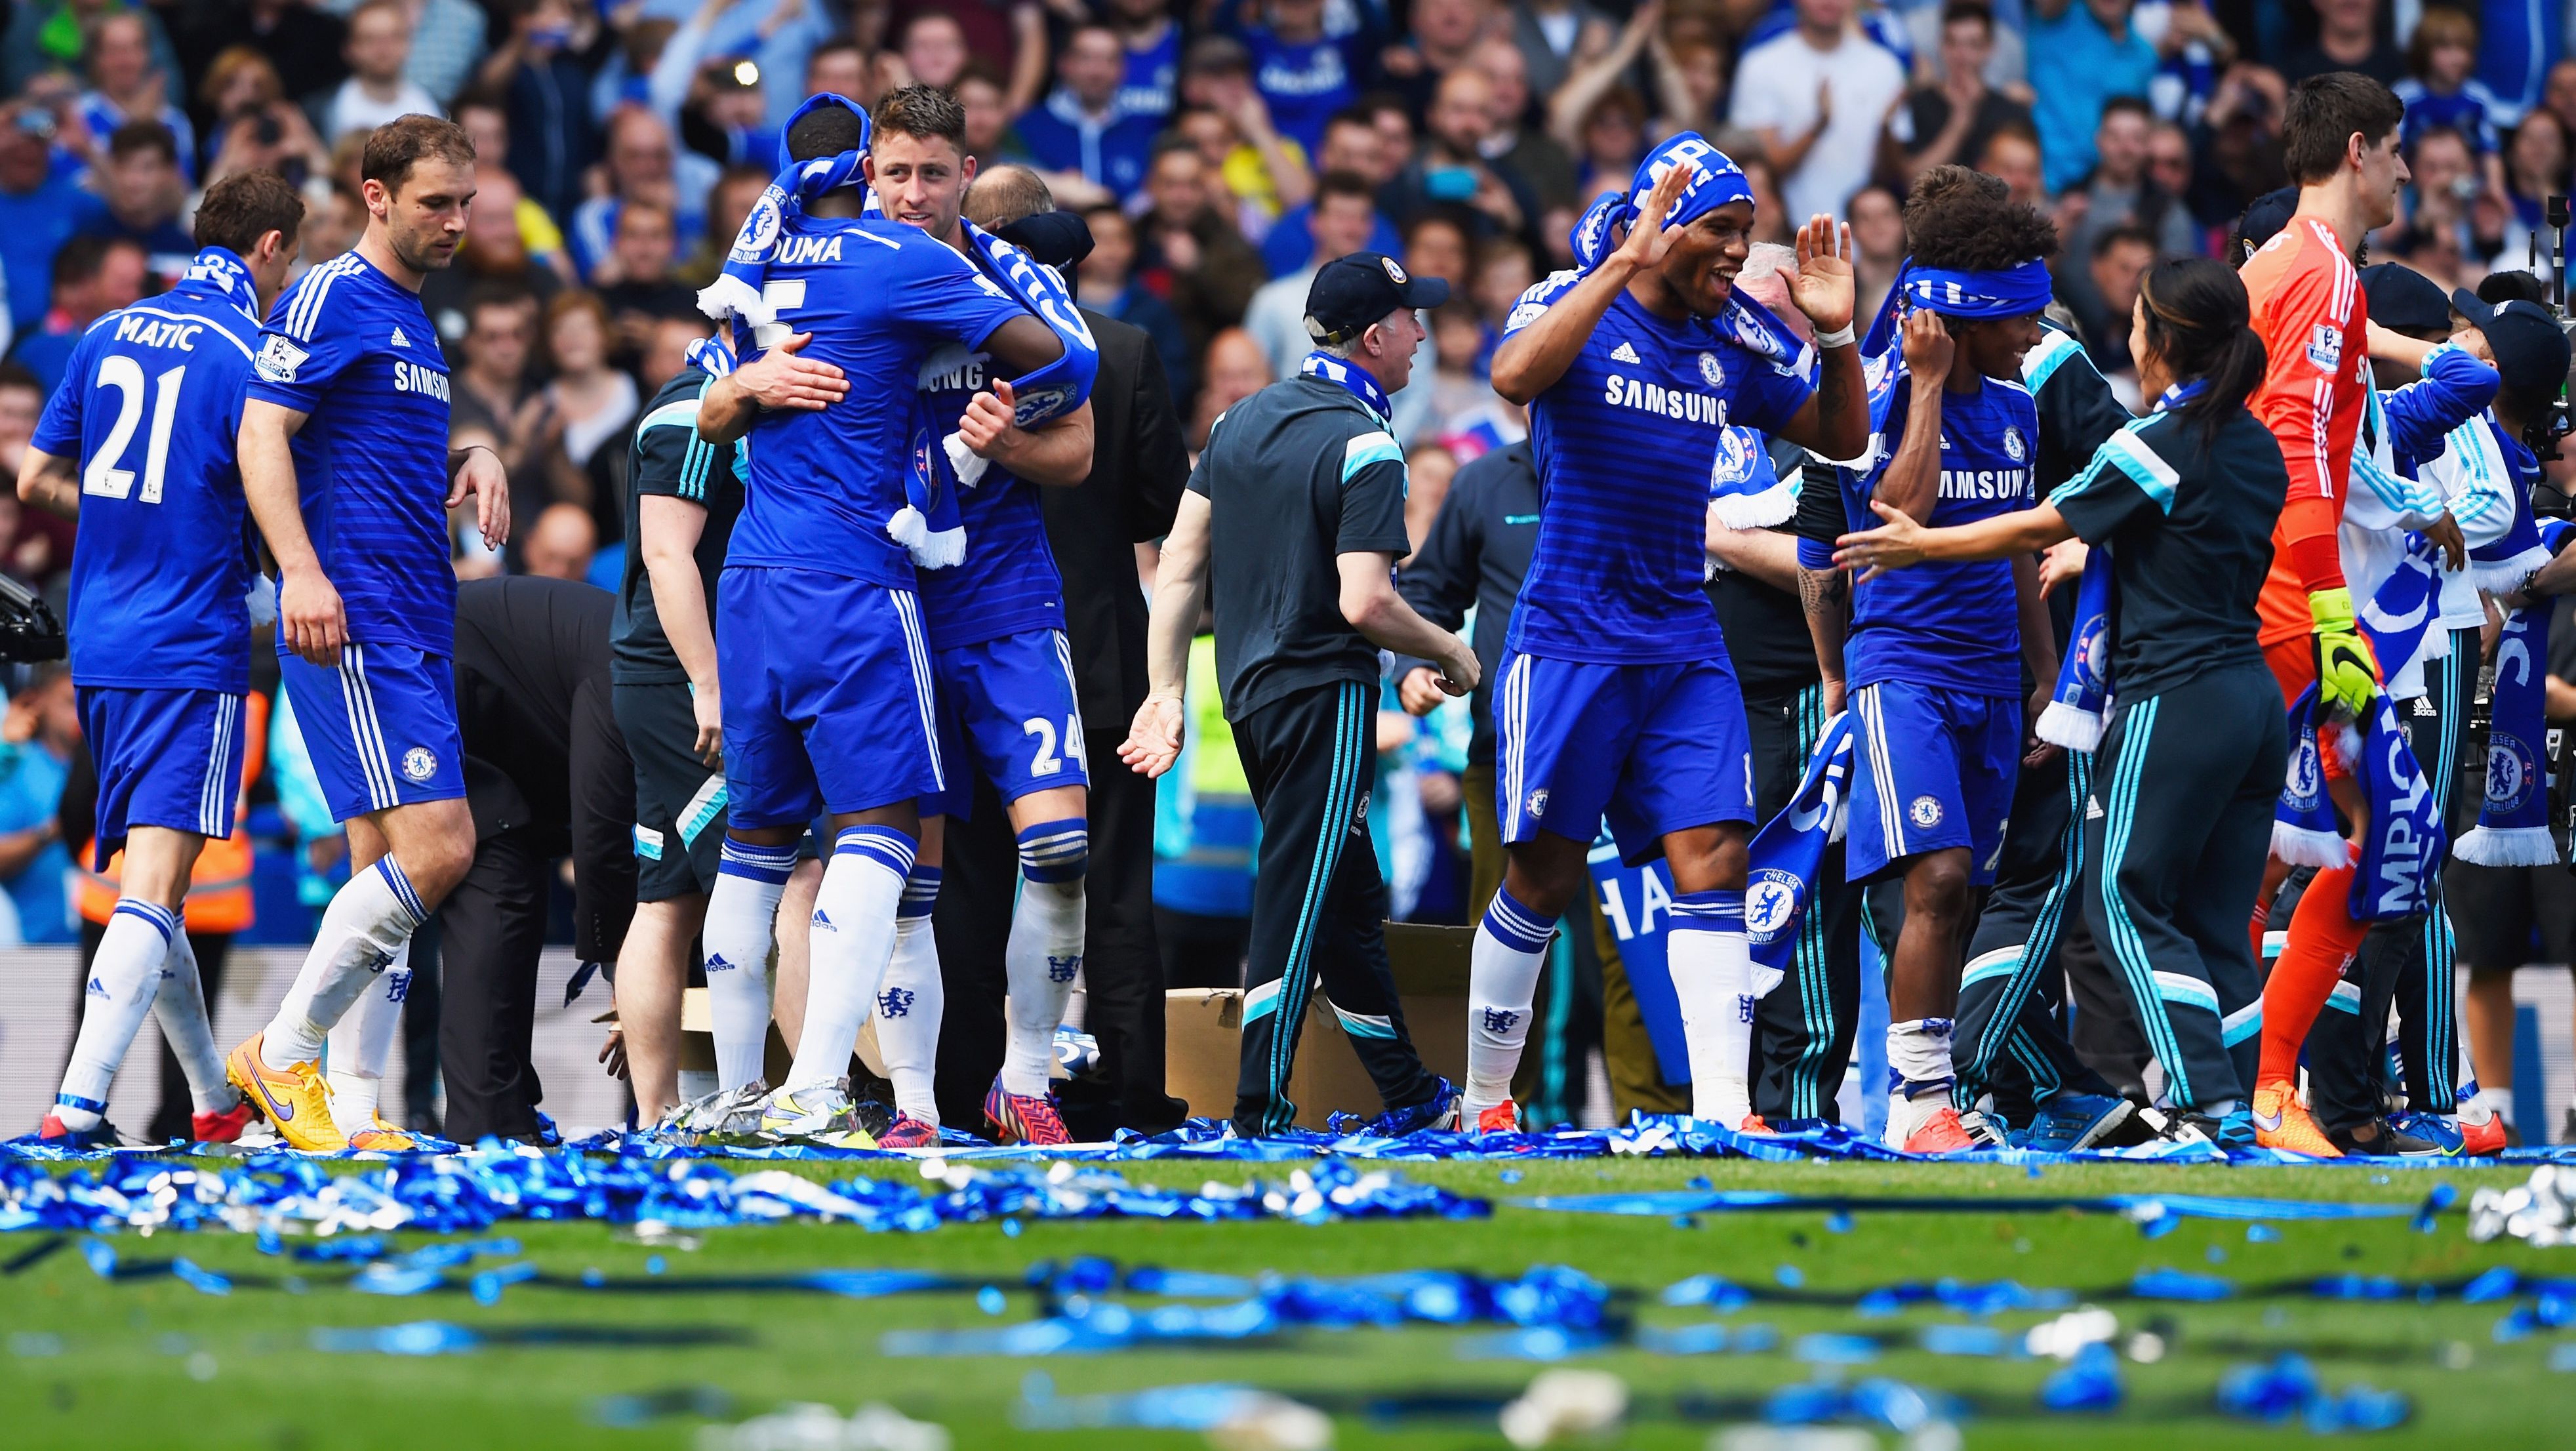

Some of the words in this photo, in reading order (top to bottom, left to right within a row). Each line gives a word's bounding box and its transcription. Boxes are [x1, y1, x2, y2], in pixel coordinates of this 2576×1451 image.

[767, 235, 843, 263] OUMA
[114, 315, 203, 352] MATIC
[754, 279, 807, 351] 5
[1611, 352, 1641, 365] adidas
[1605, 375, 1727, 428] SAMSUNG
[83, 355, 186, 504] 21
[1937, 468, 2025, 499] AMSUN
[1023, 713, 1086, 777] 24
[1763, 870, 1799, 891] CHELSEA
